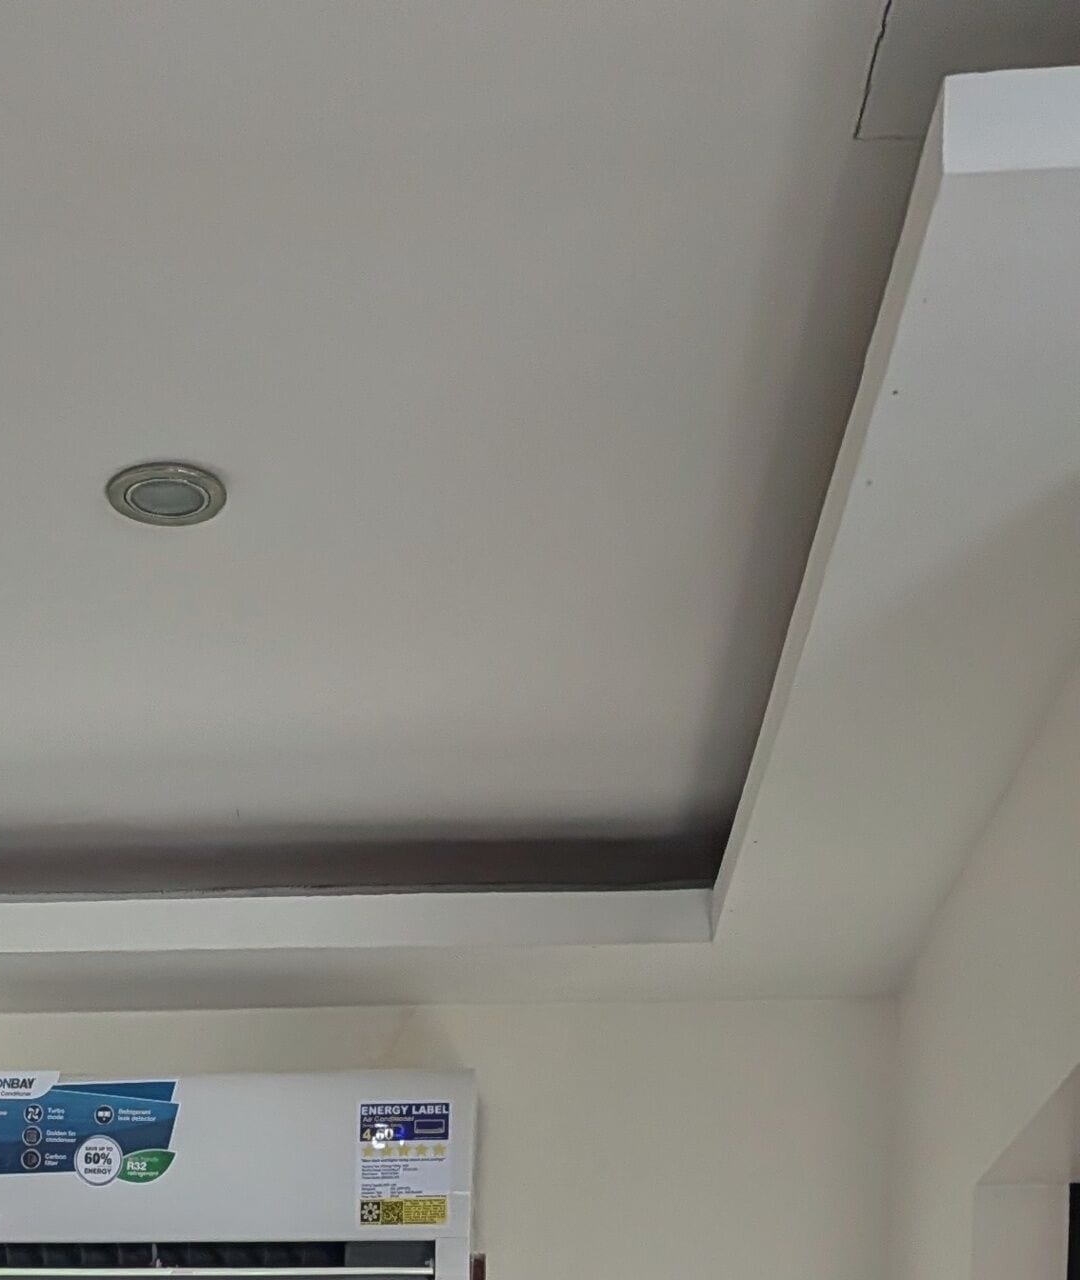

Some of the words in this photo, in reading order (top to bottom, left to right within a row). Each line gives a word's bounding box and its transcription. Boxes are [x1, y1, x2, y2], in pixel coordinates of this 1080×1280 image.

[361, 1105, 408, 1115] ENERGY
[411, 1104, 449, 1114] LABEL
[84, 1151, 113, 1165] 60%
[126, 1160, 148, 1171] R32
